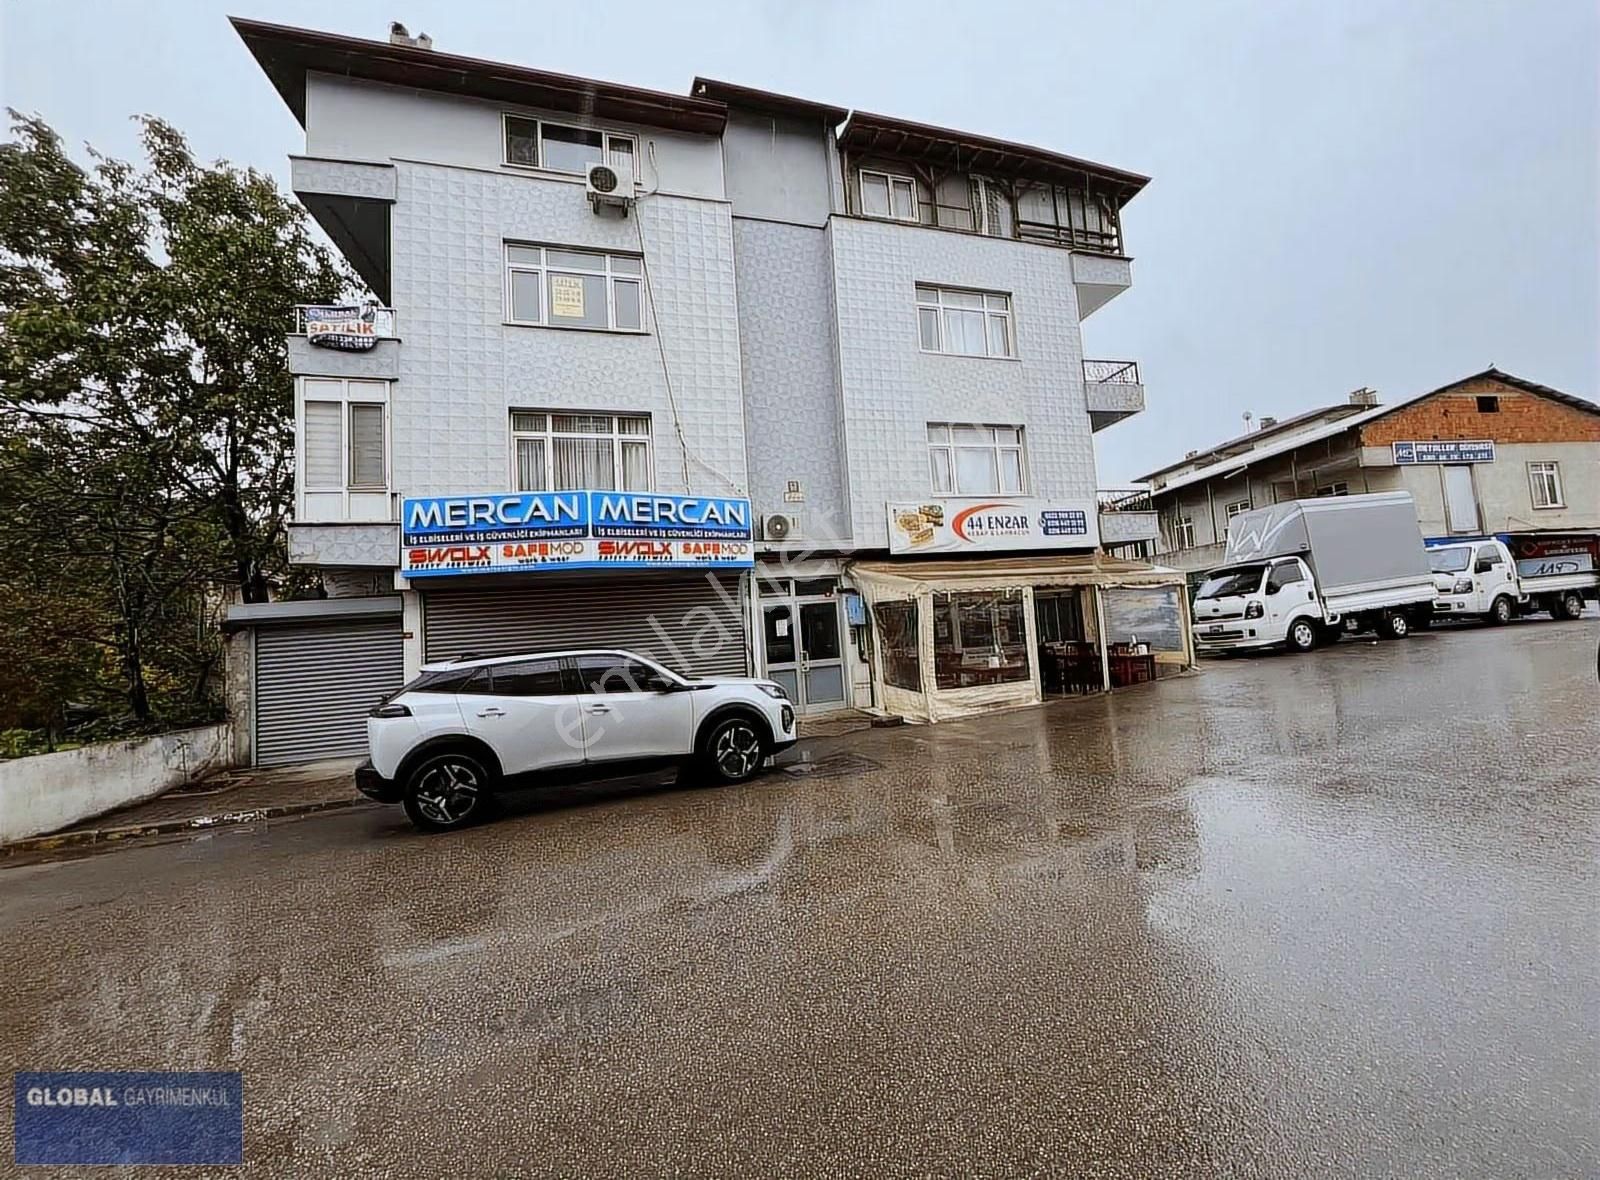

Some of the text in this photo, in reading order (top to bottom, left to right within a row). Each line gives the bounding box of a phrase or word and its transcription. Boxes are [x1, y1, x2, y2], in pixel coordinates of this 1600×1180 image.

[409, 495, 579, 528] MERCAN
[599, 495, 745, 526] MERCAN
[967, 516, 983, 530] 44
[465, 532, 476, 541] VE
[649, 528, 658, 536] VE
[408, 546, 491, 563] SWOLX
[503, 542, 584, 557] SAFEMOD
[598, 541, 672, 555] SWOLX
[683, 543, 748, 554] SAFEMOD
